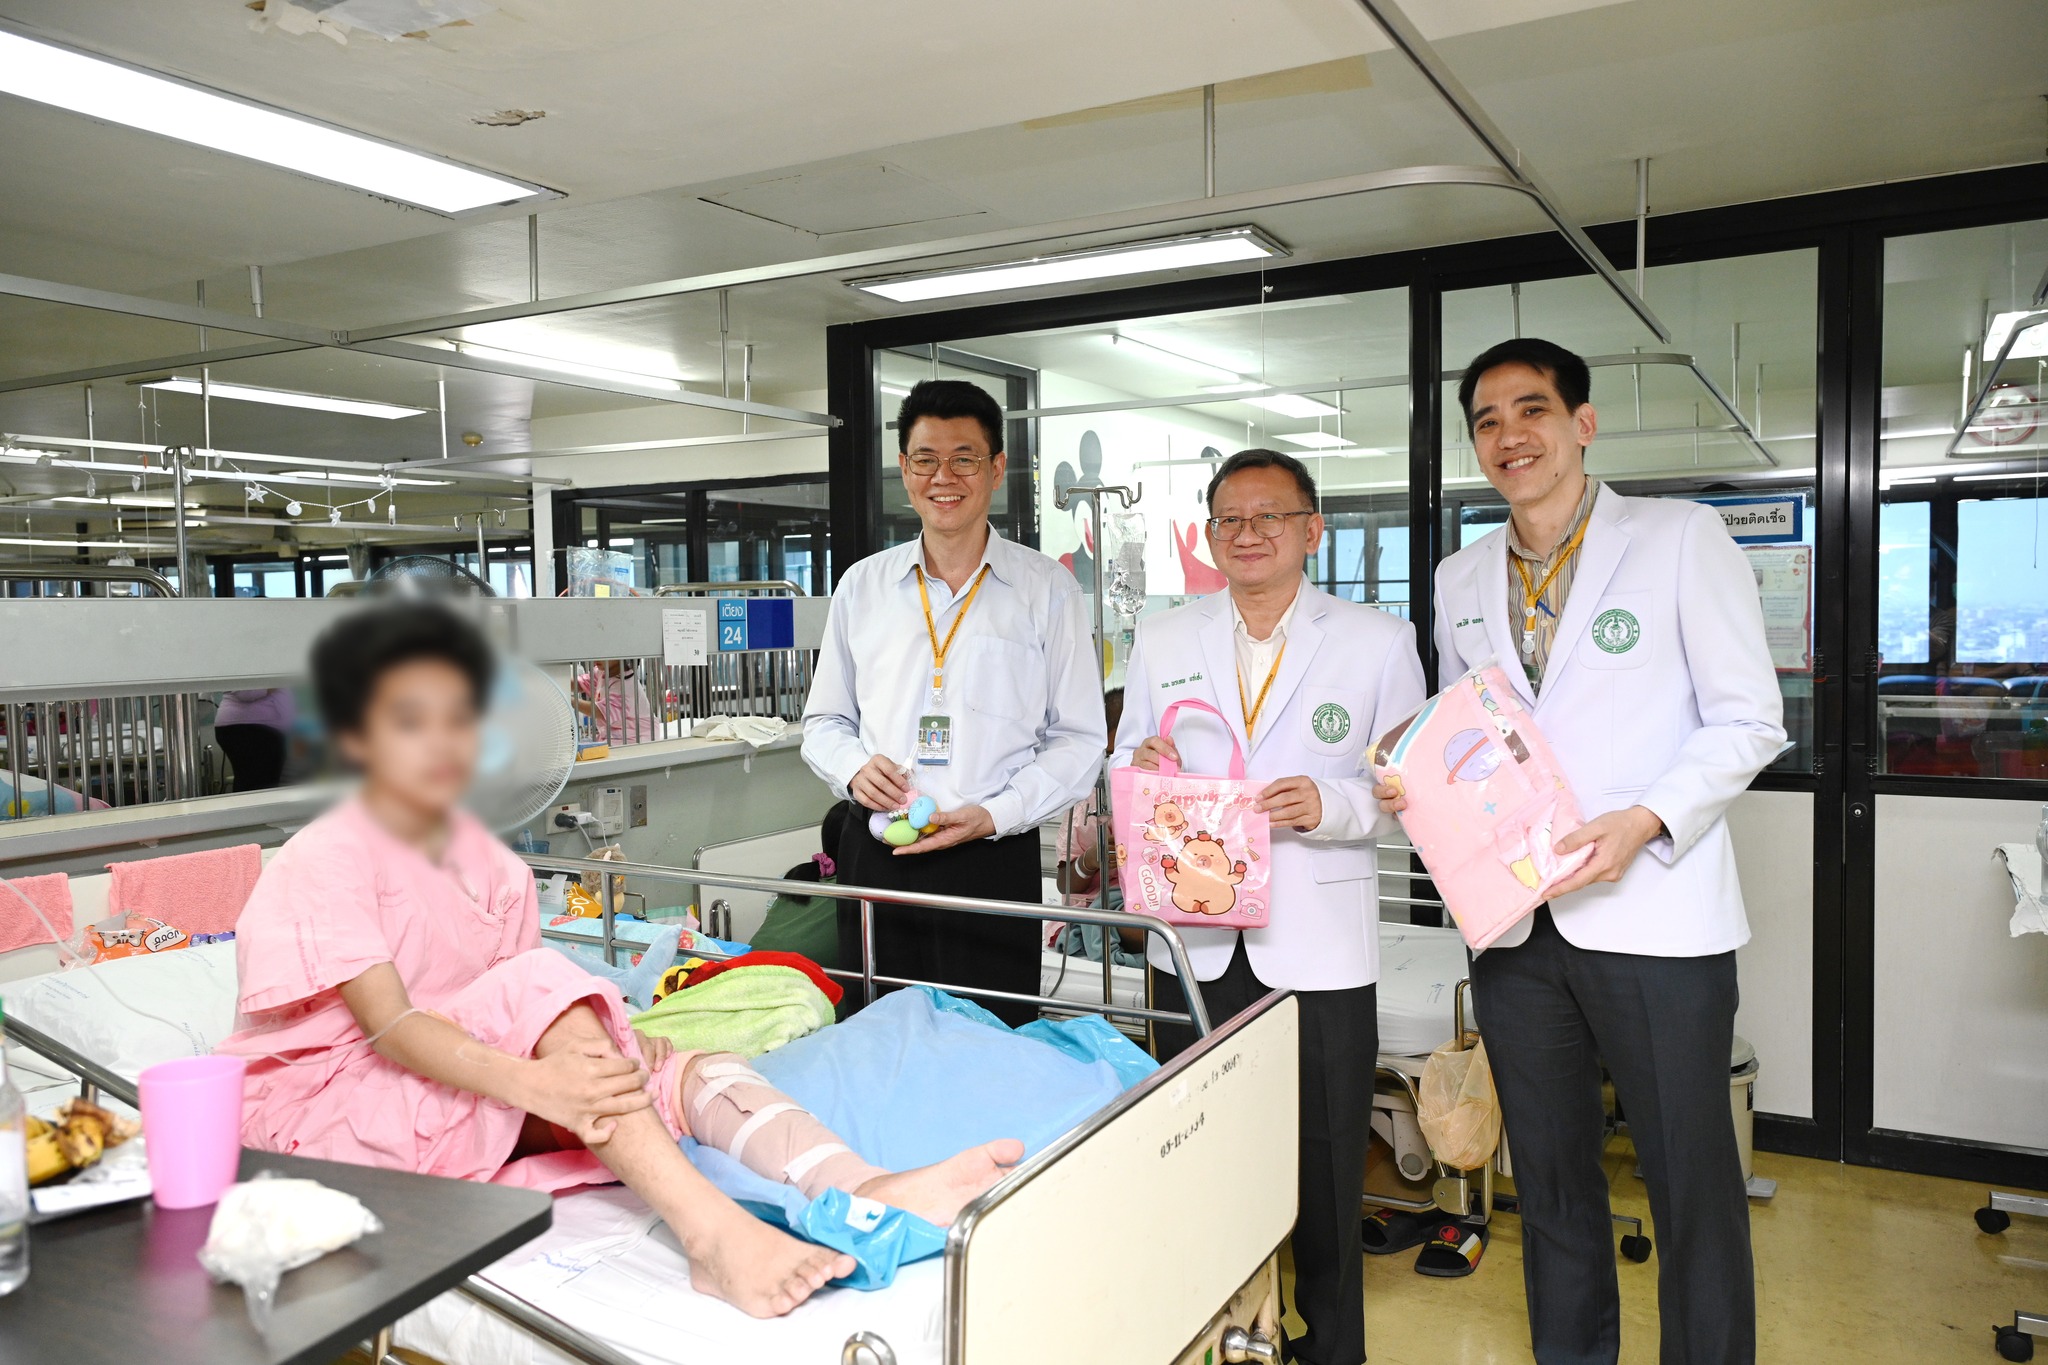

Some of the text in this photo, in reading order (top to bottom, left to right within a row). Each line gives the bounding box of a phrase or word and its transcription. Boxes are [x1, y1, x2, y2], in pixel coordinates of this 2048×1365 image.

[1720, 507, 1786, 526] ้ป่วยติดเชื้อ
[722, 602, 743, 617] เตียง
[724, 626, 742, 645] 24
[1141, 868, 1160, 908] GOOD!!
